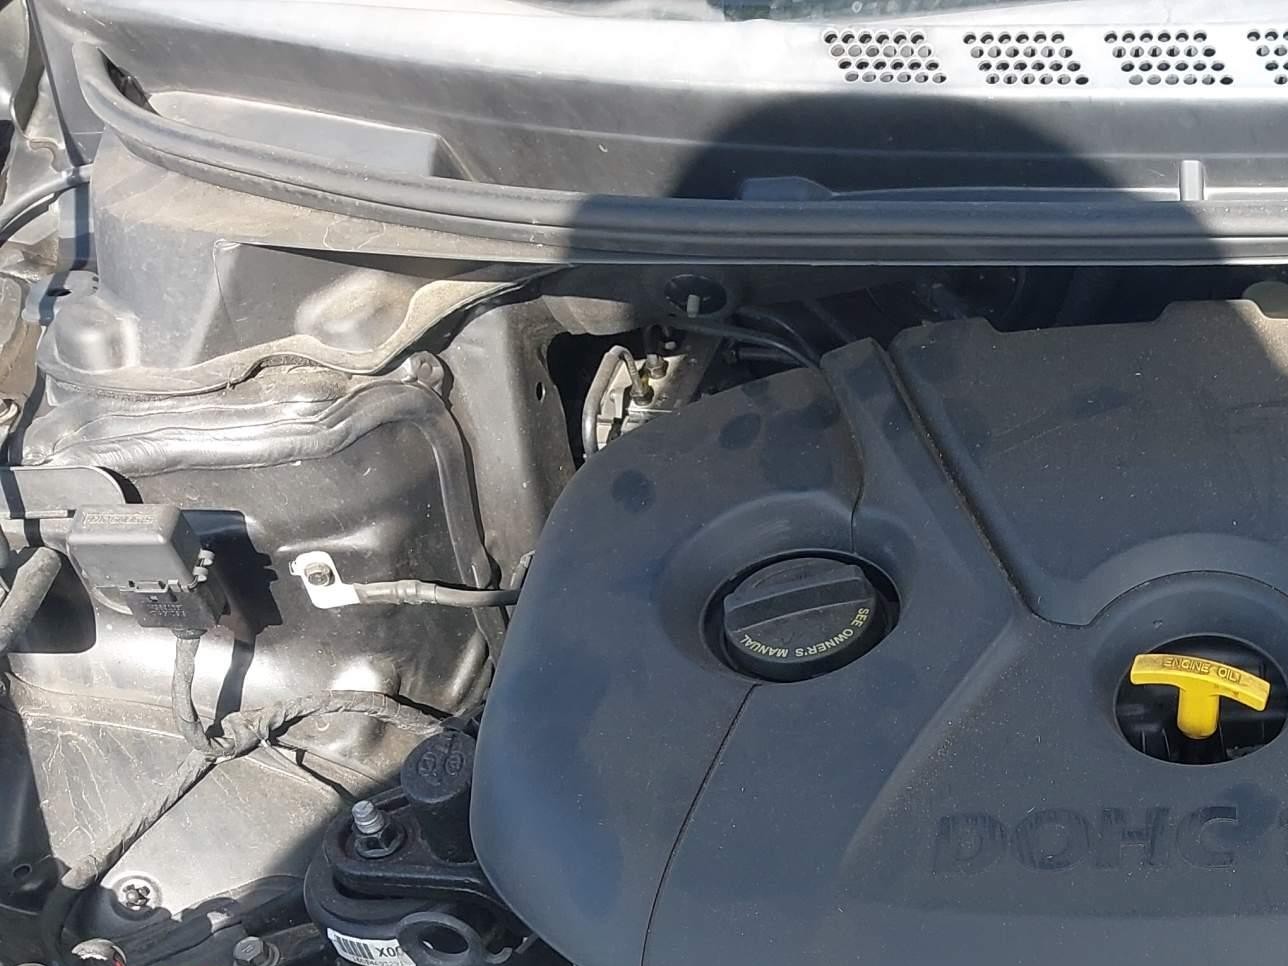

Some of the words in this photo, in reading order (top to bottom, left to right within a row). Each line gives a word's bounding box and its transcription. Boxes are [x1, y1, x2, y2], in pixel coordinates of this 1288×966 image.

[850, 607, 870, 628] SEE
[739, 634, 789, 658] MANUAL
[795, 628, 854, 657] OWNER'S
[1163, 656, 1211, 675] ENGINE
[1217, 667, 1242, 682] OIL
[933, 805, 1239, 872] DOHC
